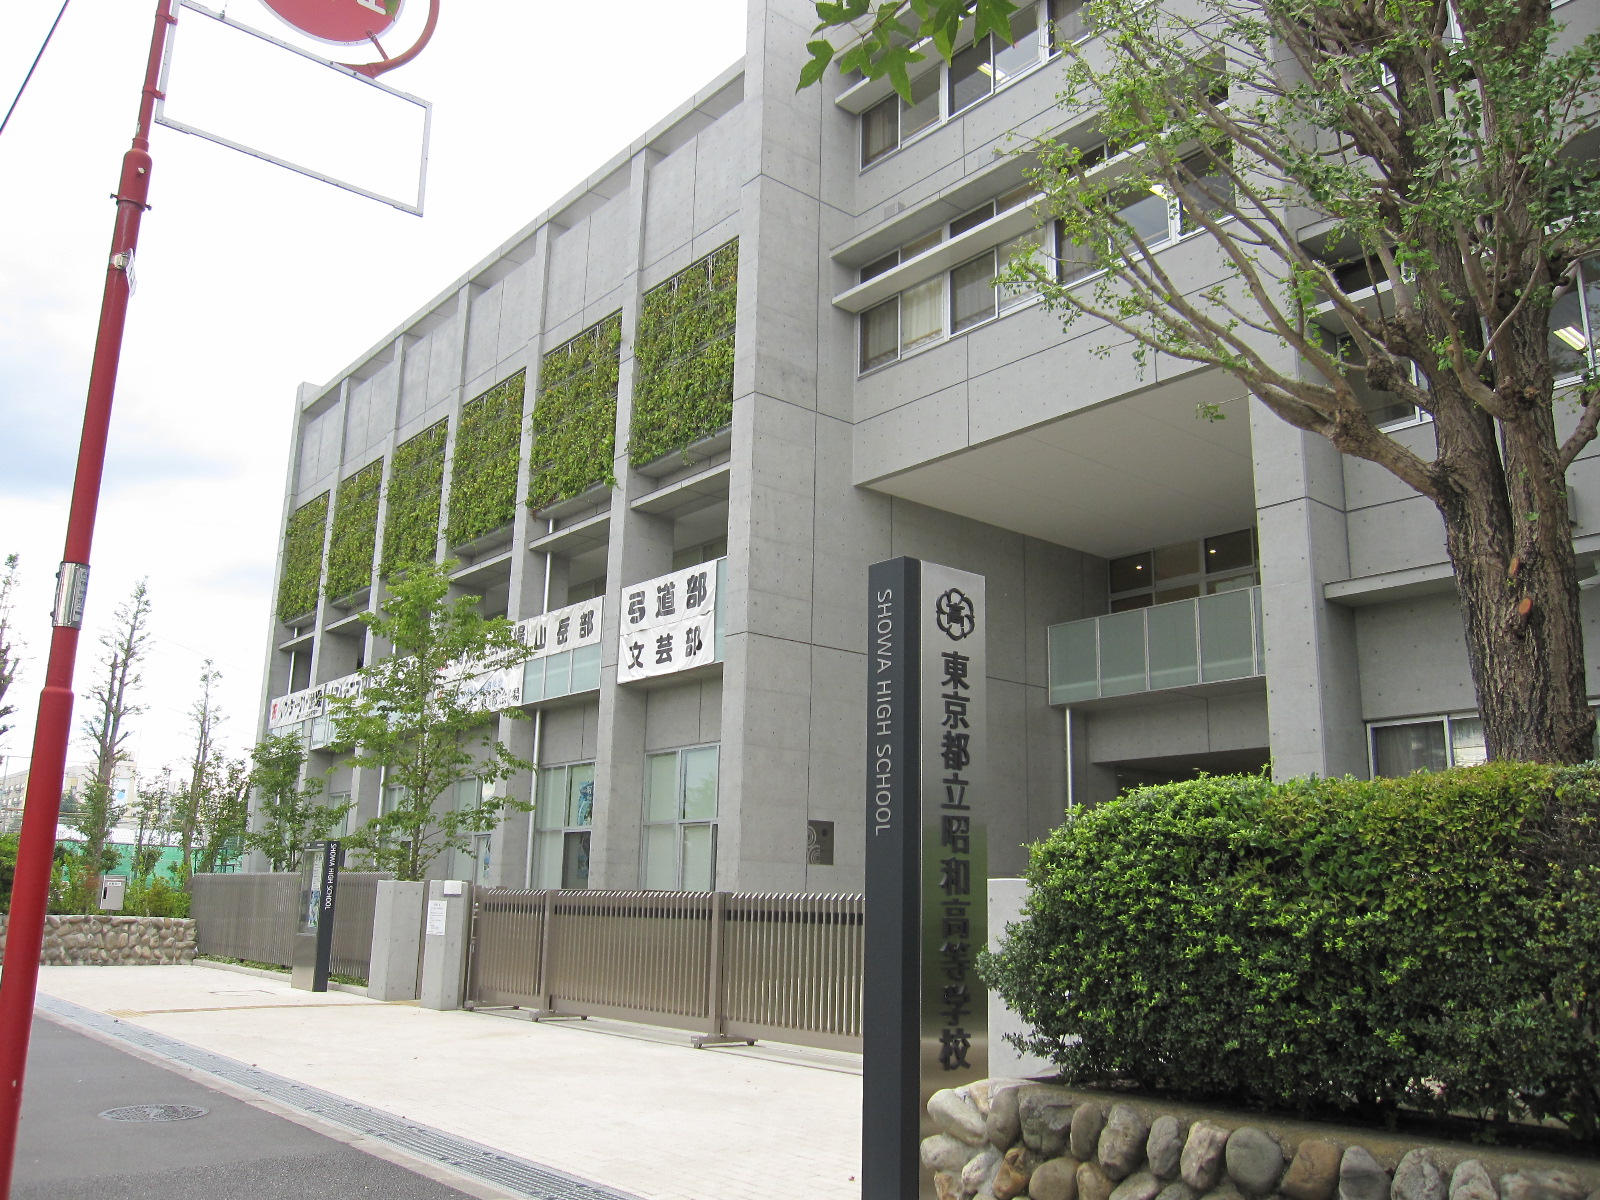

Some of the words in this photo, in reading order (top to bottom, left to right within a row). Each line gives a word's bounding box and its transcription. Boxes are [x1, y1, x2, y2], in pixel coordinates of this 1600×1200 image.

[628, 571, 707, 624] 弓道部
[534, 609, 594, 650] 山岳部
[628, 625, 702, 669] 文芸部
[877, 588, 892, 673] SHOWA
[876, 680, 892, 736] HIGH
[875, 744, 892, 836] SCHOOL
[327, 868, 335, 884] HIGH
[329, 843, 337, 866] SHOWA
[939, 651, 971, 1071] 東京都立昭和高等学校
[324, 885, 333, 910] SCHOOL
